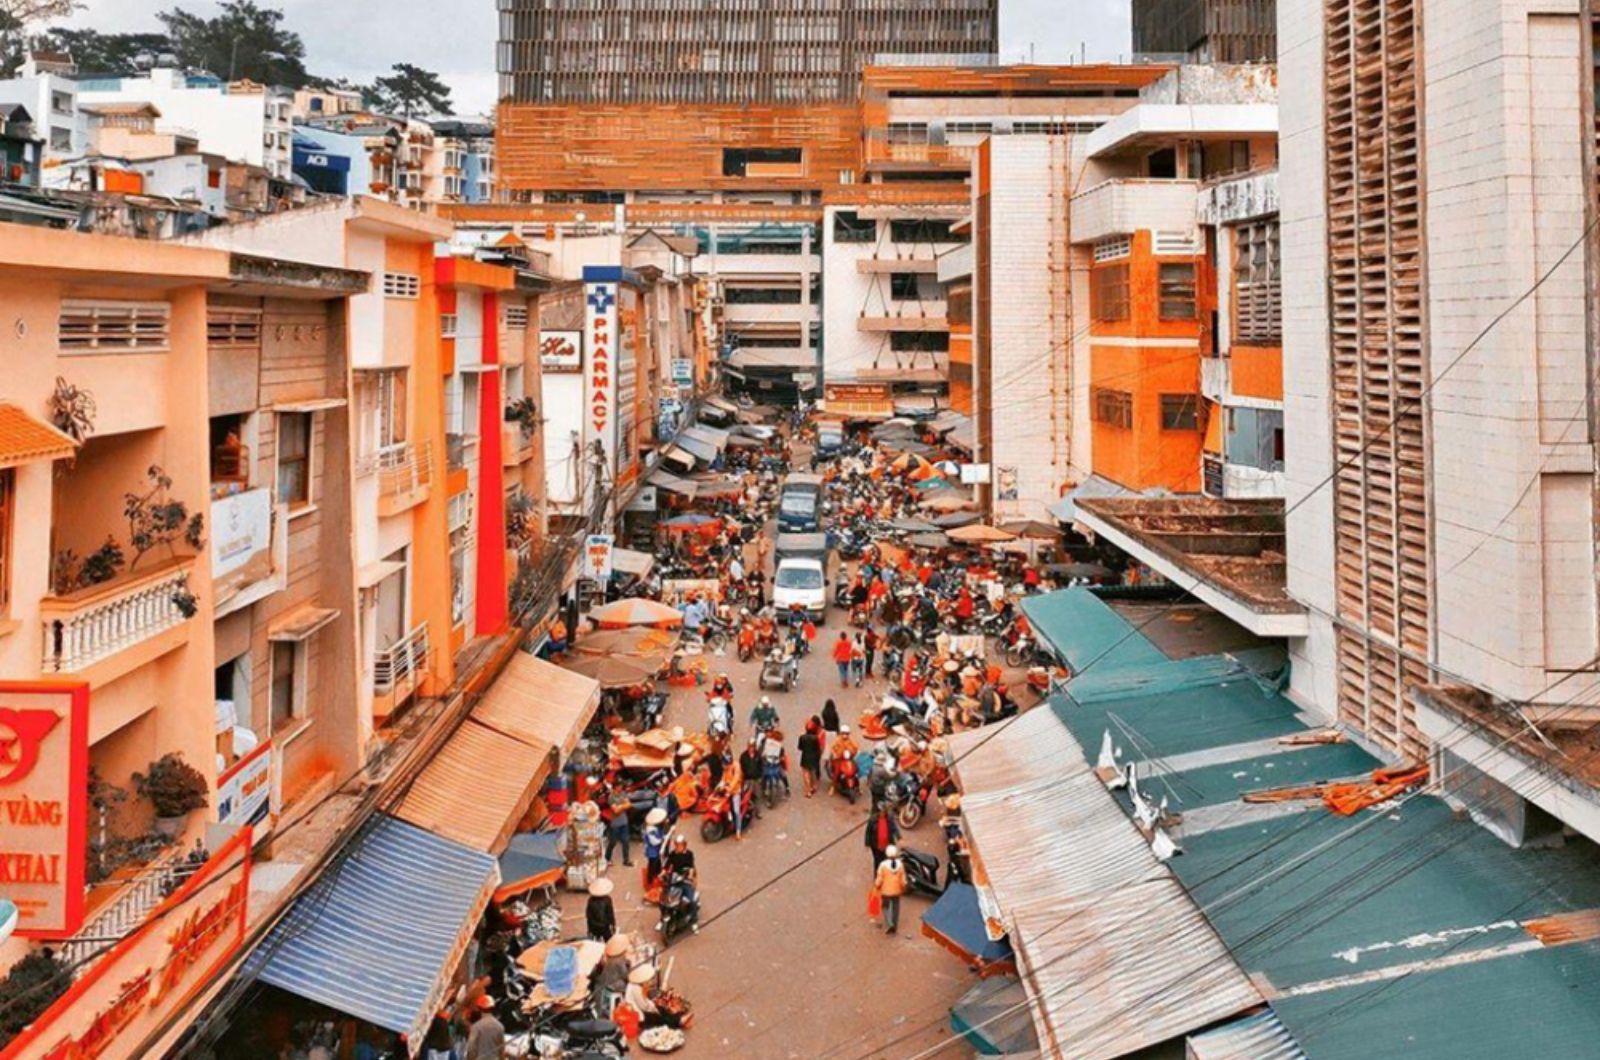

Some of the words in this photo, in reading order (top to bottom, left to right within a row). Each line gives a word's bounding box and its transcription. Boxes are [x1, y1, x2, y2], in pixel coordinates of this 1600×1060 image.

[306, 154, 328, 167] ACB
[592, 317, 609, 432] PHARMACY
[6, 793, 62, 826] VÀNG
